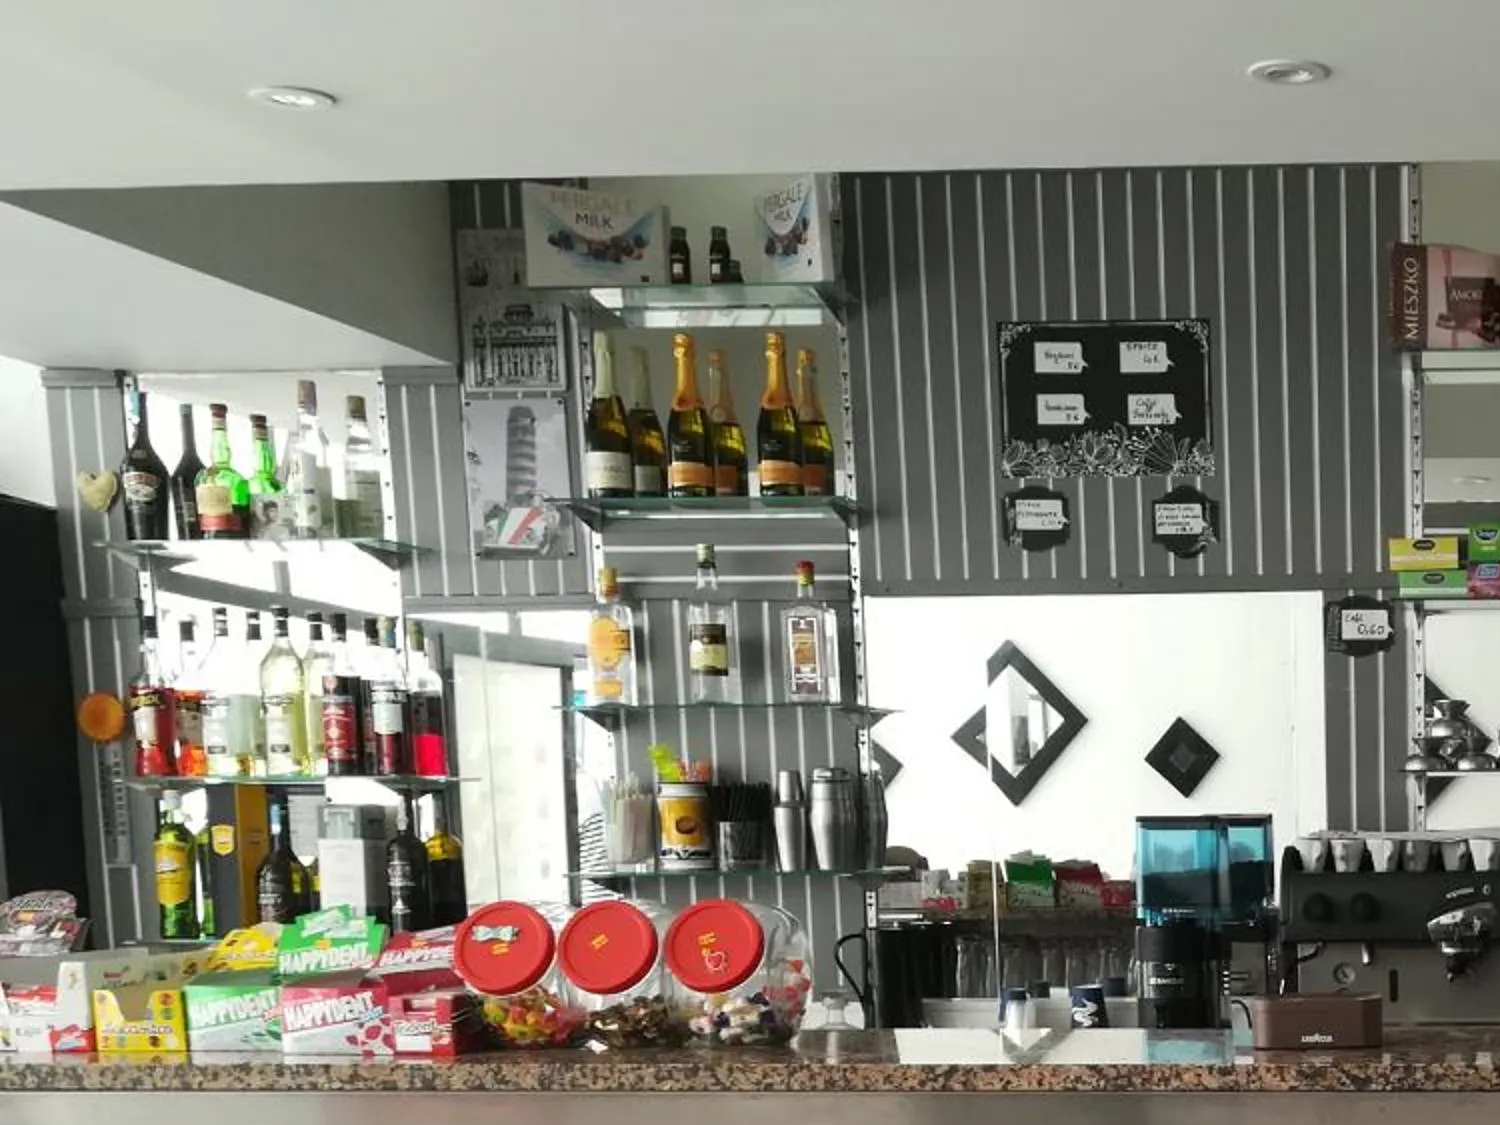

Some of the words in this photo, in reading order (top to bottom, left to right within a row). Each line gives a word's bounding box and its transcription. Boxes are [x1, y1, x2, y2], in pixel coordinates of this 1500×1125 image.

[575, 210, 614, 229] MILK
[1403, 256, 1420, 341] MIESZKO
[279, 942, 370, 974] HAPPYDENT
[190, 987, 277, 1028] HAPPYDENT
[283, 991, 374, 1031] HAPPYDENT
